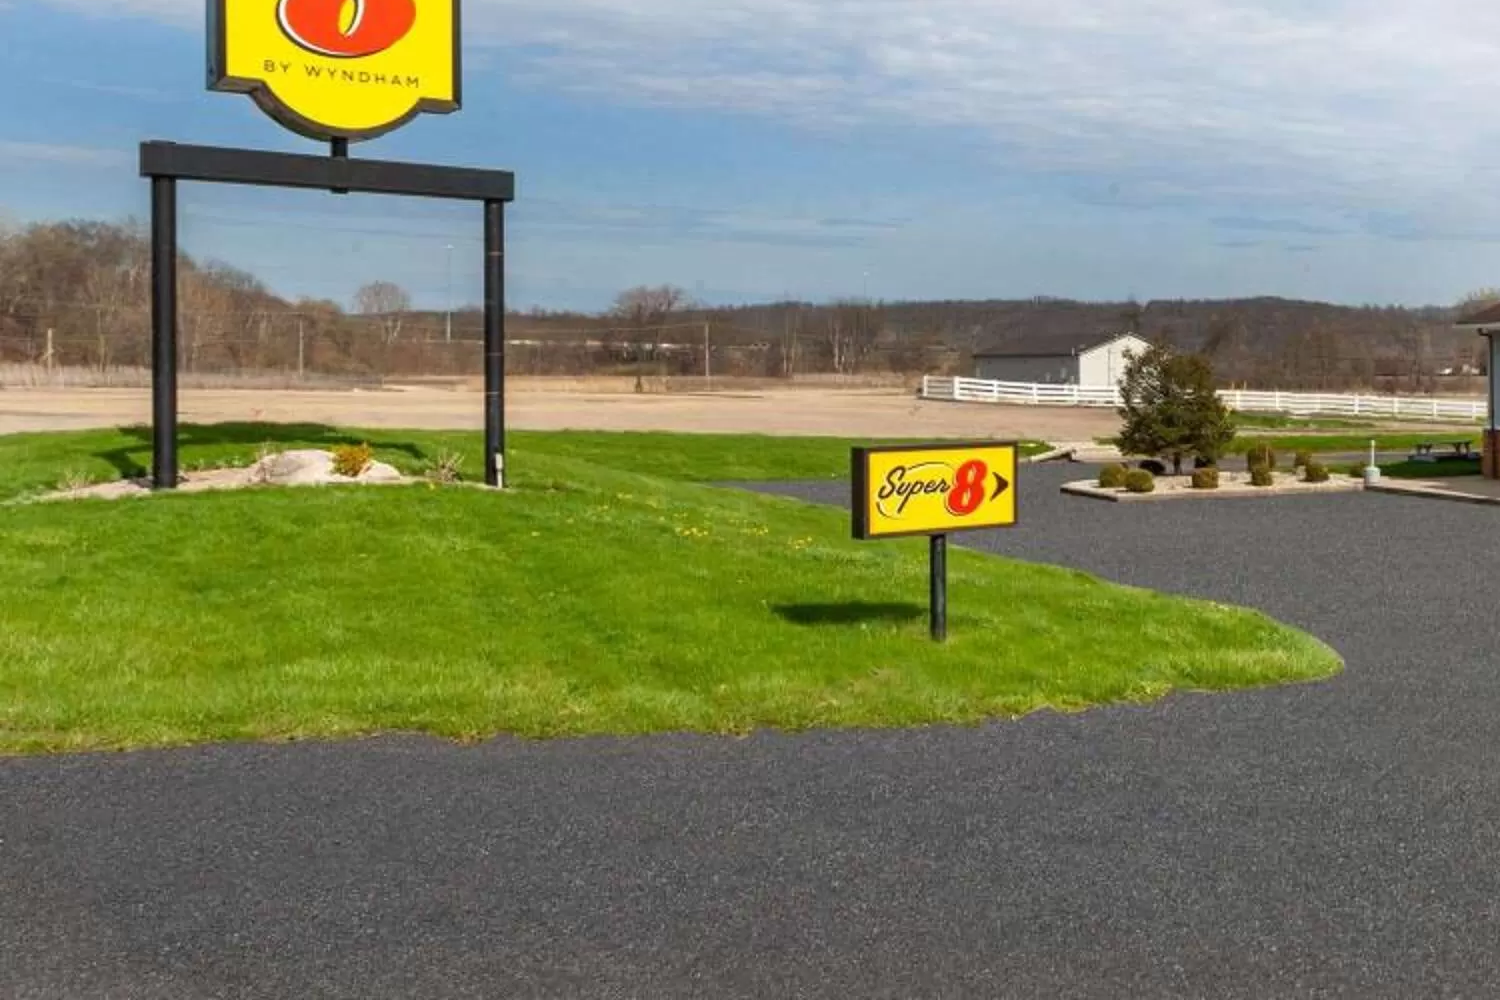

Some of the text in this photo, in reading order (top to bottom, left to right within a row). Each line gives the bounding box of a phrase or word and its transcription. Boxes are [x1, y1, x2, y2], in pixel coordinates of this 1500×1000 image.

[263, 60, 419, 88] BY WYNDHAM
[878, 459, 987, 516] Super 8
